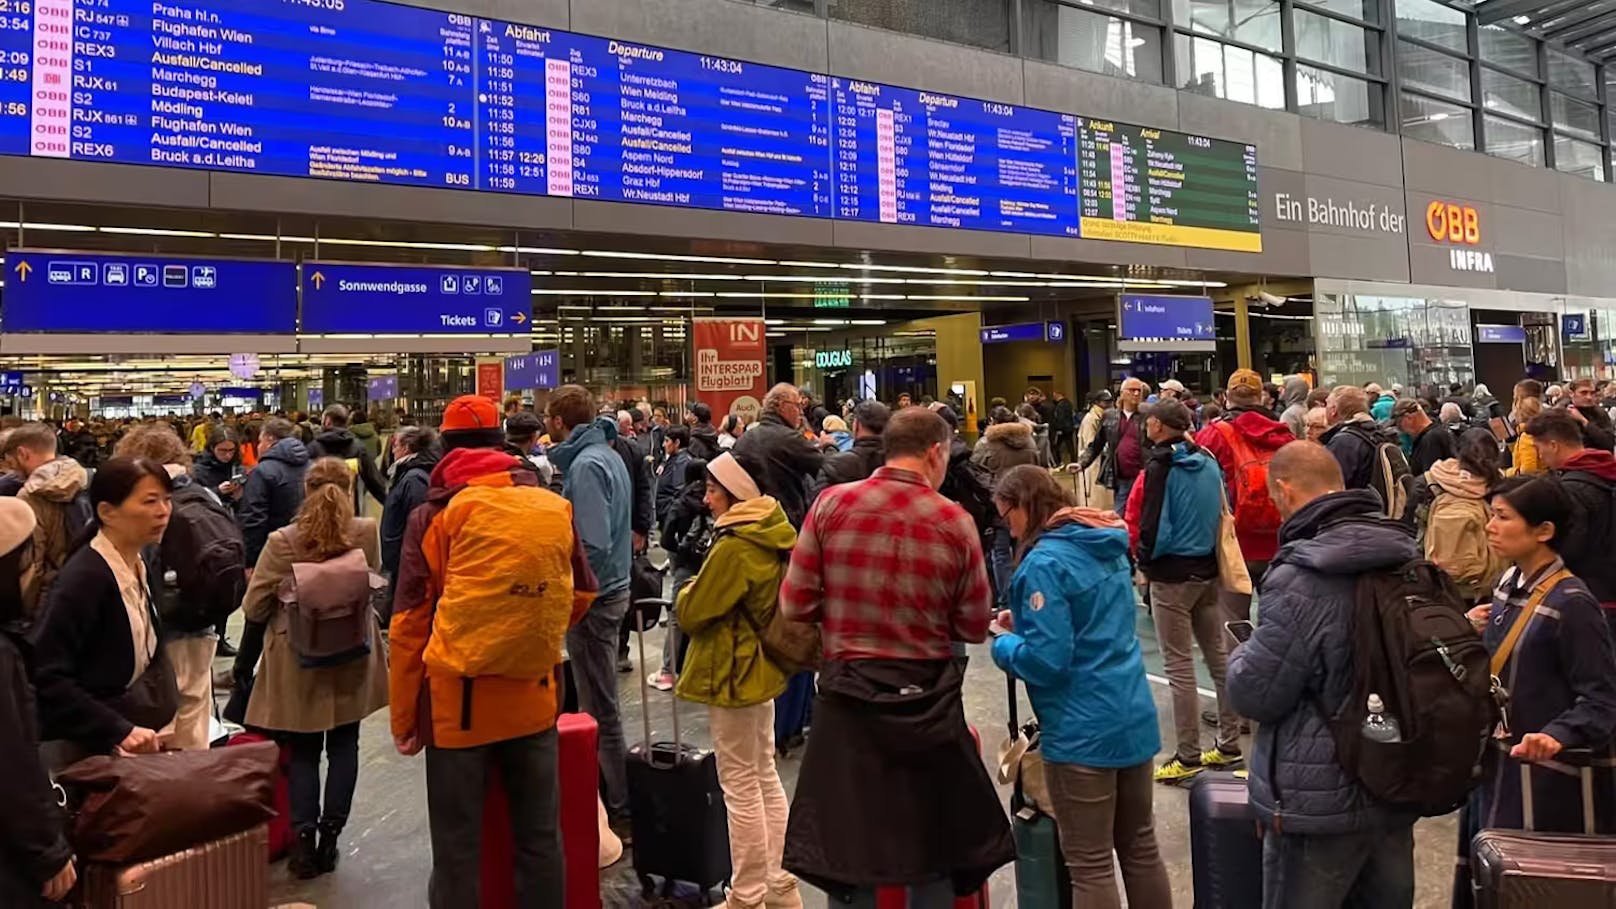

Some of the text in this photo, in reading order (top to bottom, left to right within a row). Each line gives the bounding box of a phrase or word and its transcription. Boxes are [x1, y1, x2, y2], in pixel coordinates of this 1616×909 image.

[75, 9, 94, 22] RJ
[152, 2, 222, 24] Praha hl.n.
[75, 26, 111, 41] IC 737
[152, 19, 253, 43] Flughafen Wien
[74, 42, 115, 58] REX3
[152, 34, 222, 55] Villach Hbf
[505, 24, 742, 74] Abfahrt Departure 11:43:04
[443, 46, 454, 57] 11
[74, 59, 92, 72] S1
[152, 51, 263, 76] Ausfall/Cancelled
[442, 59, 455, 71] 10
[487, 53, 513, 65] 11:50
[152, 67, 217, 88] Marchegg
[487, 66, 513, 79] 11:50
[571, 65, 597, 78] REX3
[73, 75, 117, 91] RJX 61
[448, 74, 463, 86] 7 A
[487, 80, 513, 93] 11:51
[571, 78, 583, 89] S1
[620, 72, 677, 89] Unterretzbach
[73, 92, 92, 105] S2
[152, 83, 253, 106] Budapest-Keleti
[487, 93, 513, 106] 11:52
[620, 85, 678, 103] Wien Meidling
[849, 81, 1013, 116] Abfahrt Departure 11:43:04
[151, 99, 203, 119] Mödling
[448, 102, 455, 113] 2
[621, 99, 645, 111] Bruck
[811, 100, 816, 110] 2
[73, 108, 103, 123] RJX
[488, 108, 513, 119] 11:53
[621, 111, 662, 126] Marchegg
[151, 115, 252, 137] Flughafen Wien
[442, 116, 455, 128] 10
[488, 122, 514, 133] 11:55
[572, 119, 597, 130] CJX9
[72, 125, 92, 138] S2
[572, 130, 585, 141] RJ
[621, 124, 691, 141] Ausfall/Cancelled
[151, 132, 262, 153] Ausfall/Cancelled
[488, 135, 514, 147] 11:56
[621, 138, 692, 153] Ausfall/Cancelled
[72, 142, 114, 157] REX6
[448, 144, 456, 156] 9
[151, 148, 255, 168] Bruck a.d.Leitha
[488, 149, 545, 164] 11:57 12:26
[573, 157, 586, 168] S4
[622, 150, 674, 164] Aspern Nord
[488, 163, 544, 177] 11:58 12:51
[573, 170, 586, 181] RJ
[622, 163, 703, 179] Absdorf-Hippersdorf
[445, 172, 469, 185] BUS
[488, 177, 515, 189] 11:59
[622, 176, 660, 188] Graz Hbf
[574, 184, 599, 196] REX1
[813, 181, 819, 191] 2
[622, 188, 690, 203] Wr.Neustadt Hbf
[1275, 194, 1404, 233] Ein Bahnhof der
[1425, 199, 1480, 244] ÖBB
[1450, 249, 1494, 273] INFRA
[81, 268, 91, 279] R
[339, 279, 427, 294] Sonnwendgasse
[440, 314, 476, 326] Tickets
[730, 323, 759, 341] IN
[701, 353, 715, 363] Ihr
[816, 350, 851, 368] DOUGLAS
[701, 363, 759, 375] INTERSPAR
[701, 376, 749, 388] Flugblatt
[736, 404, 755, 412] Auch
